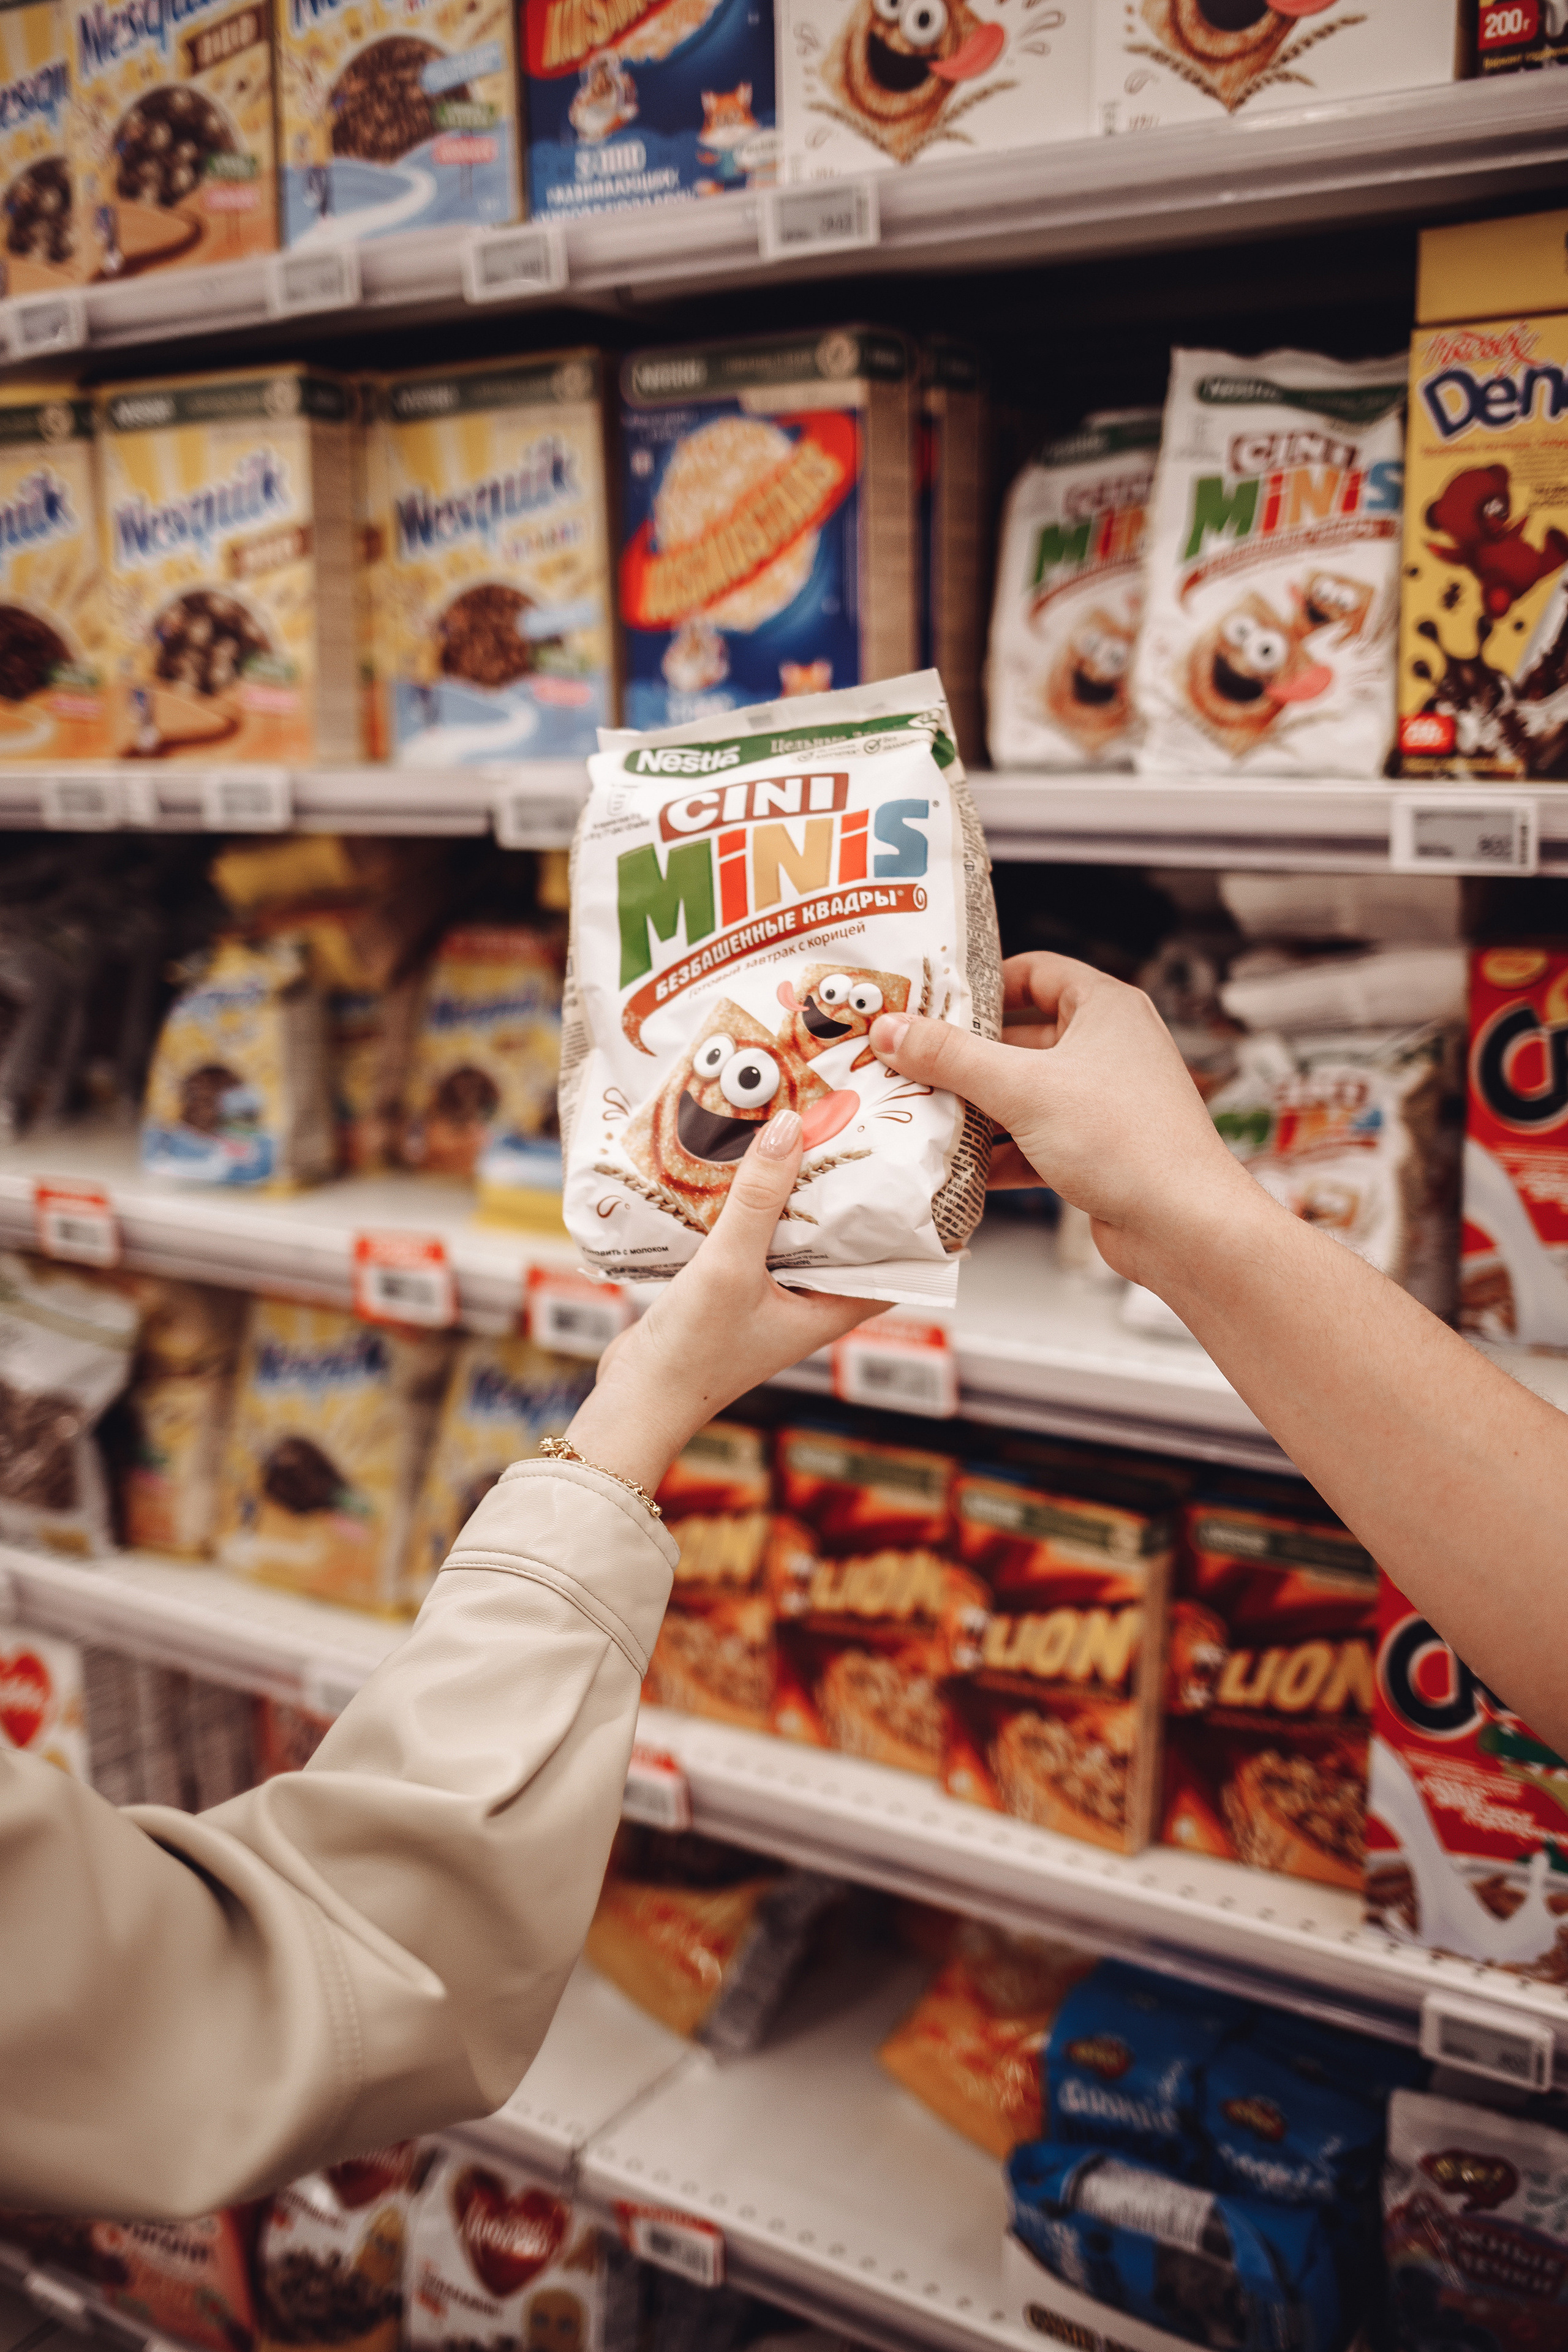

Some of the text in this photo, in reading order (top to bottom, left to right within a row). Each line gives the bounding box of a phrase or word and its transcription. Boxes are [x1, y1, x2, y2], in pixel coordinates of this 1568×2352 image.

[1423, 368, 1568, 437] Den
[636, 745, 741, 773] Nestlé
[666, 776, 835, 833] CINI
[655, 889, 897, 1001] БЕЗБАШЕННЫЕ КВАДРЫ
[744, 944, 796, 970] завтрак
[798, 941, 805, 951] с
[807, 921, 865, 949] корицей
[982, 1606, 1142, 1683] LION
